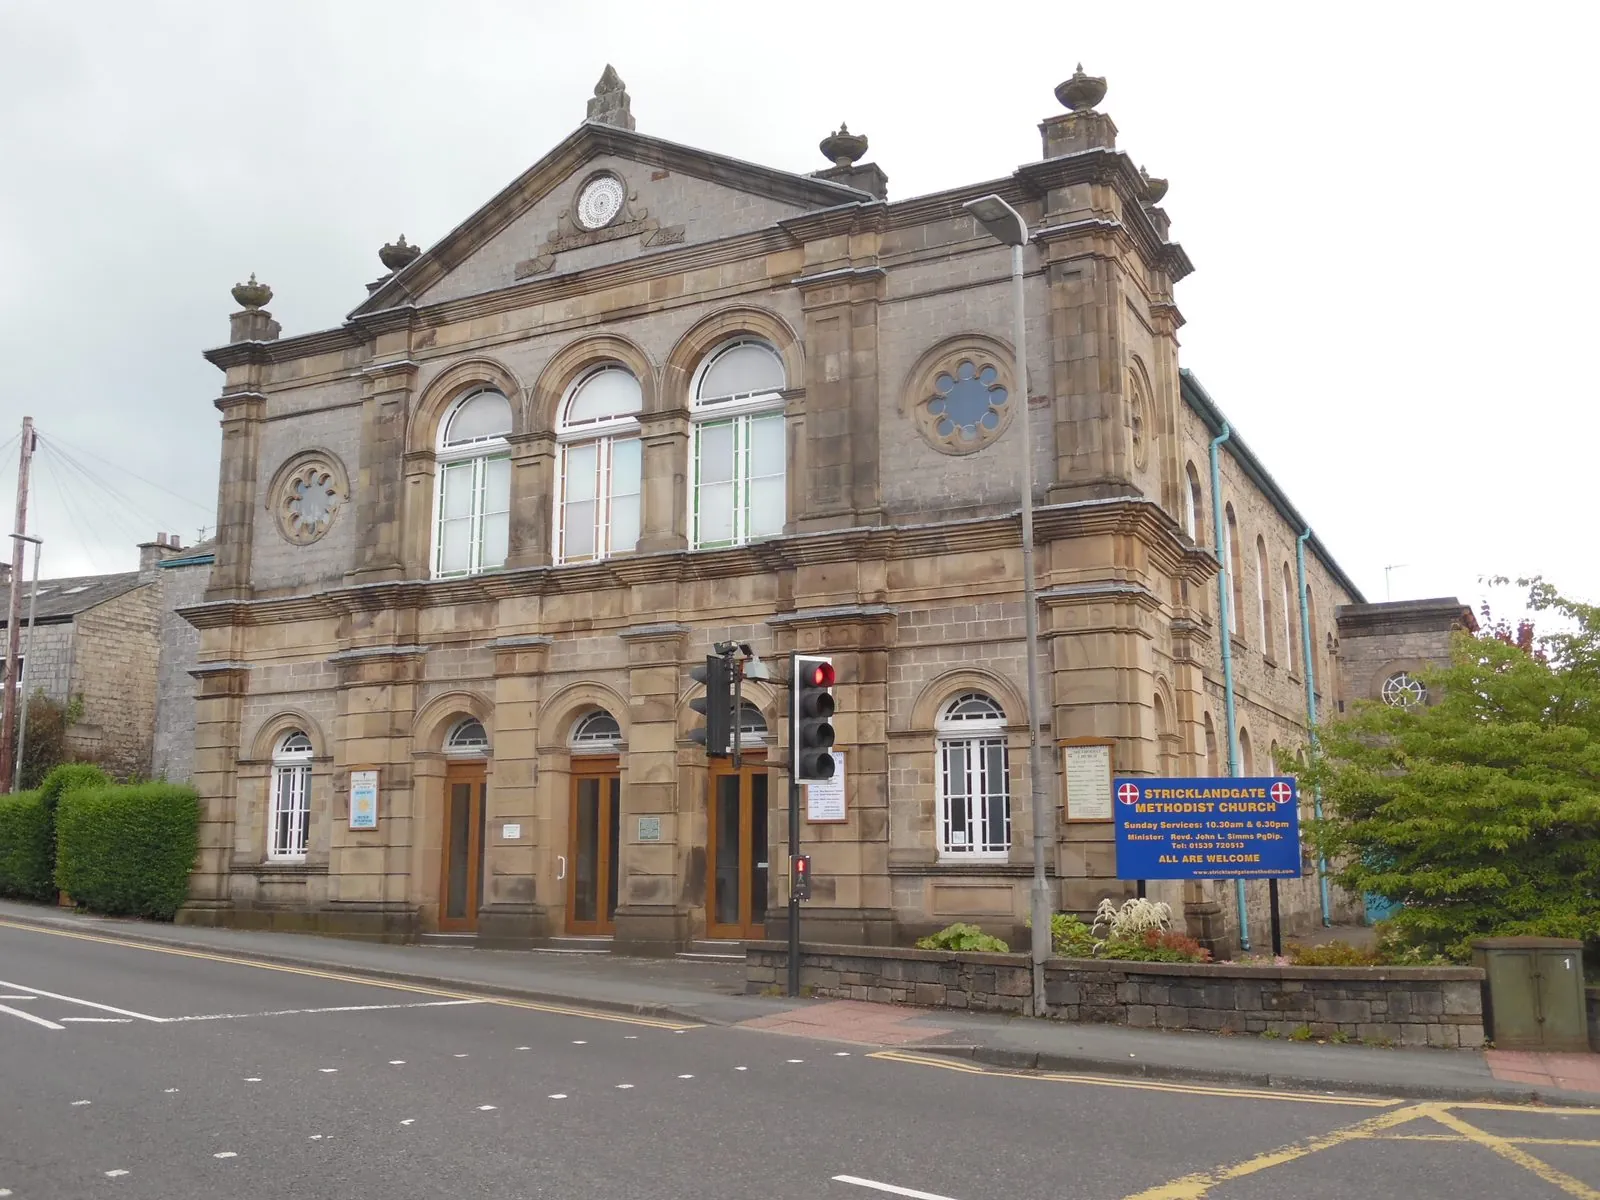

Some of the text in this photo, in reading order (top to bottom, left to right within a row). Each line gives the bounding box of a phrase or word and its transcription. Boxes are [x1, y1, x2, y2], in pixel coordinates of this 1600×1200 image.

[1144, 788, 1266, 799] STRICKLANDGATE
[1135, 802, 1276, 813] METHODIST CHURCH
[1124, 821, 1158, 830] Sunday
[1160, 821, 1203, 829] Services:
[1256, 821, 1289, 829] 6.30pm
[1256, 833, 1283, 841] PgDip.
[1159, 854, 1260, 863] ALL ARE WELCOME
[1564, 958, 1570, 969] 1
